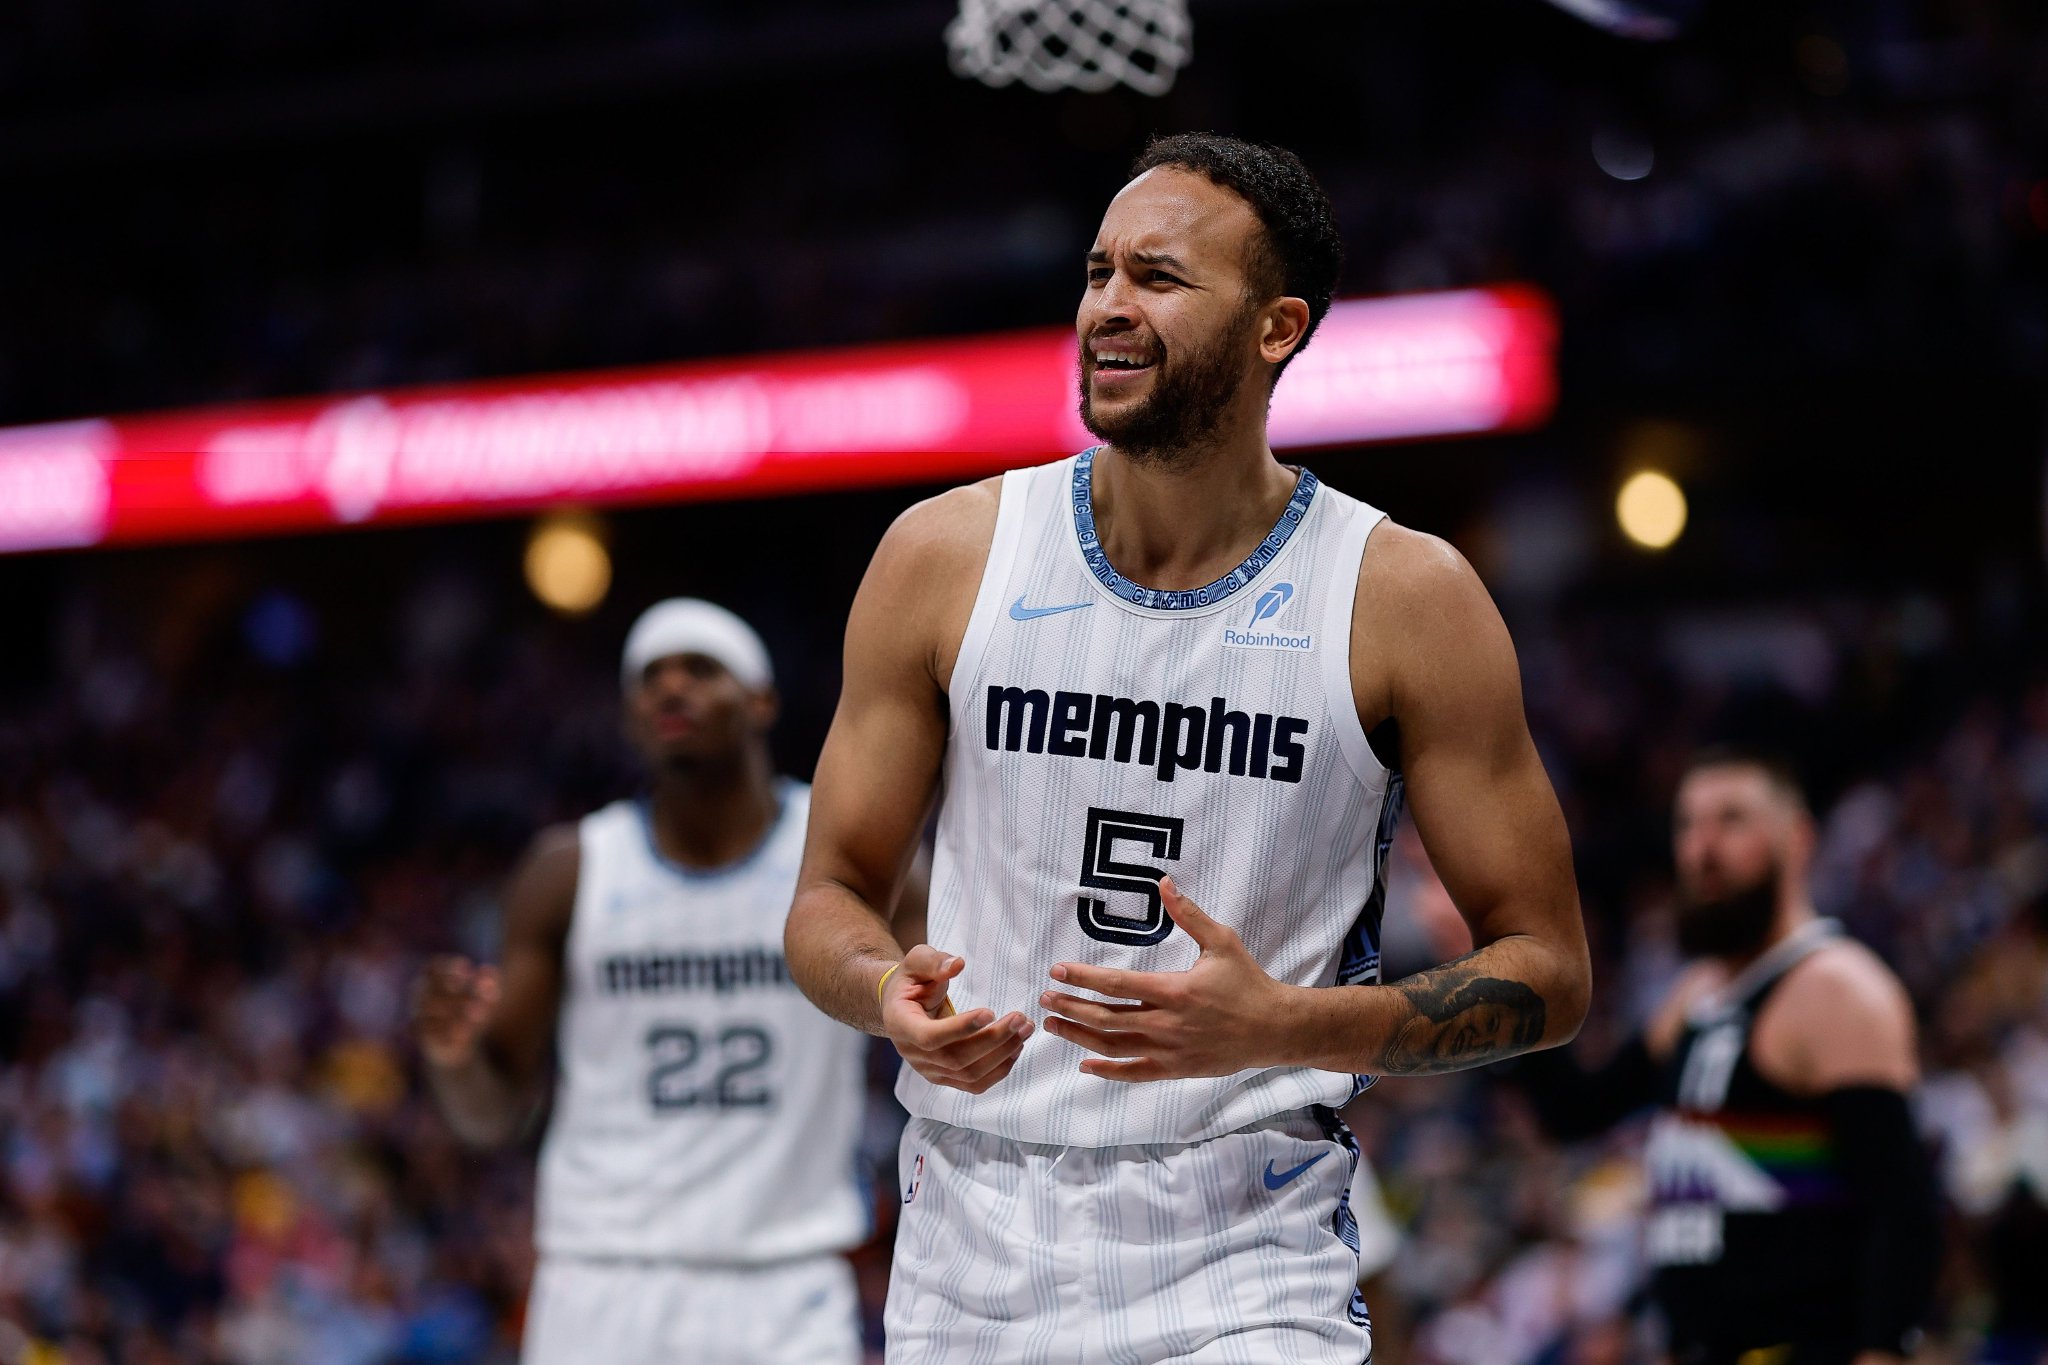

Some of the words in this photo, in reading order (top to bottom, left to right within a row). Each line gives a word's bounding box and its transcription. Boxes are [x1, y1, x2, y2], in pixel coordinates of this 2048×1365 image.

[1224, 629, 1311, 649] Robinhood
[985, 684, 1309, 783] memphis
[1077, 806, 1184, 946] 5
[601, 946, 791, 992] memphi
[646, 1025, 774, 1110] 22
